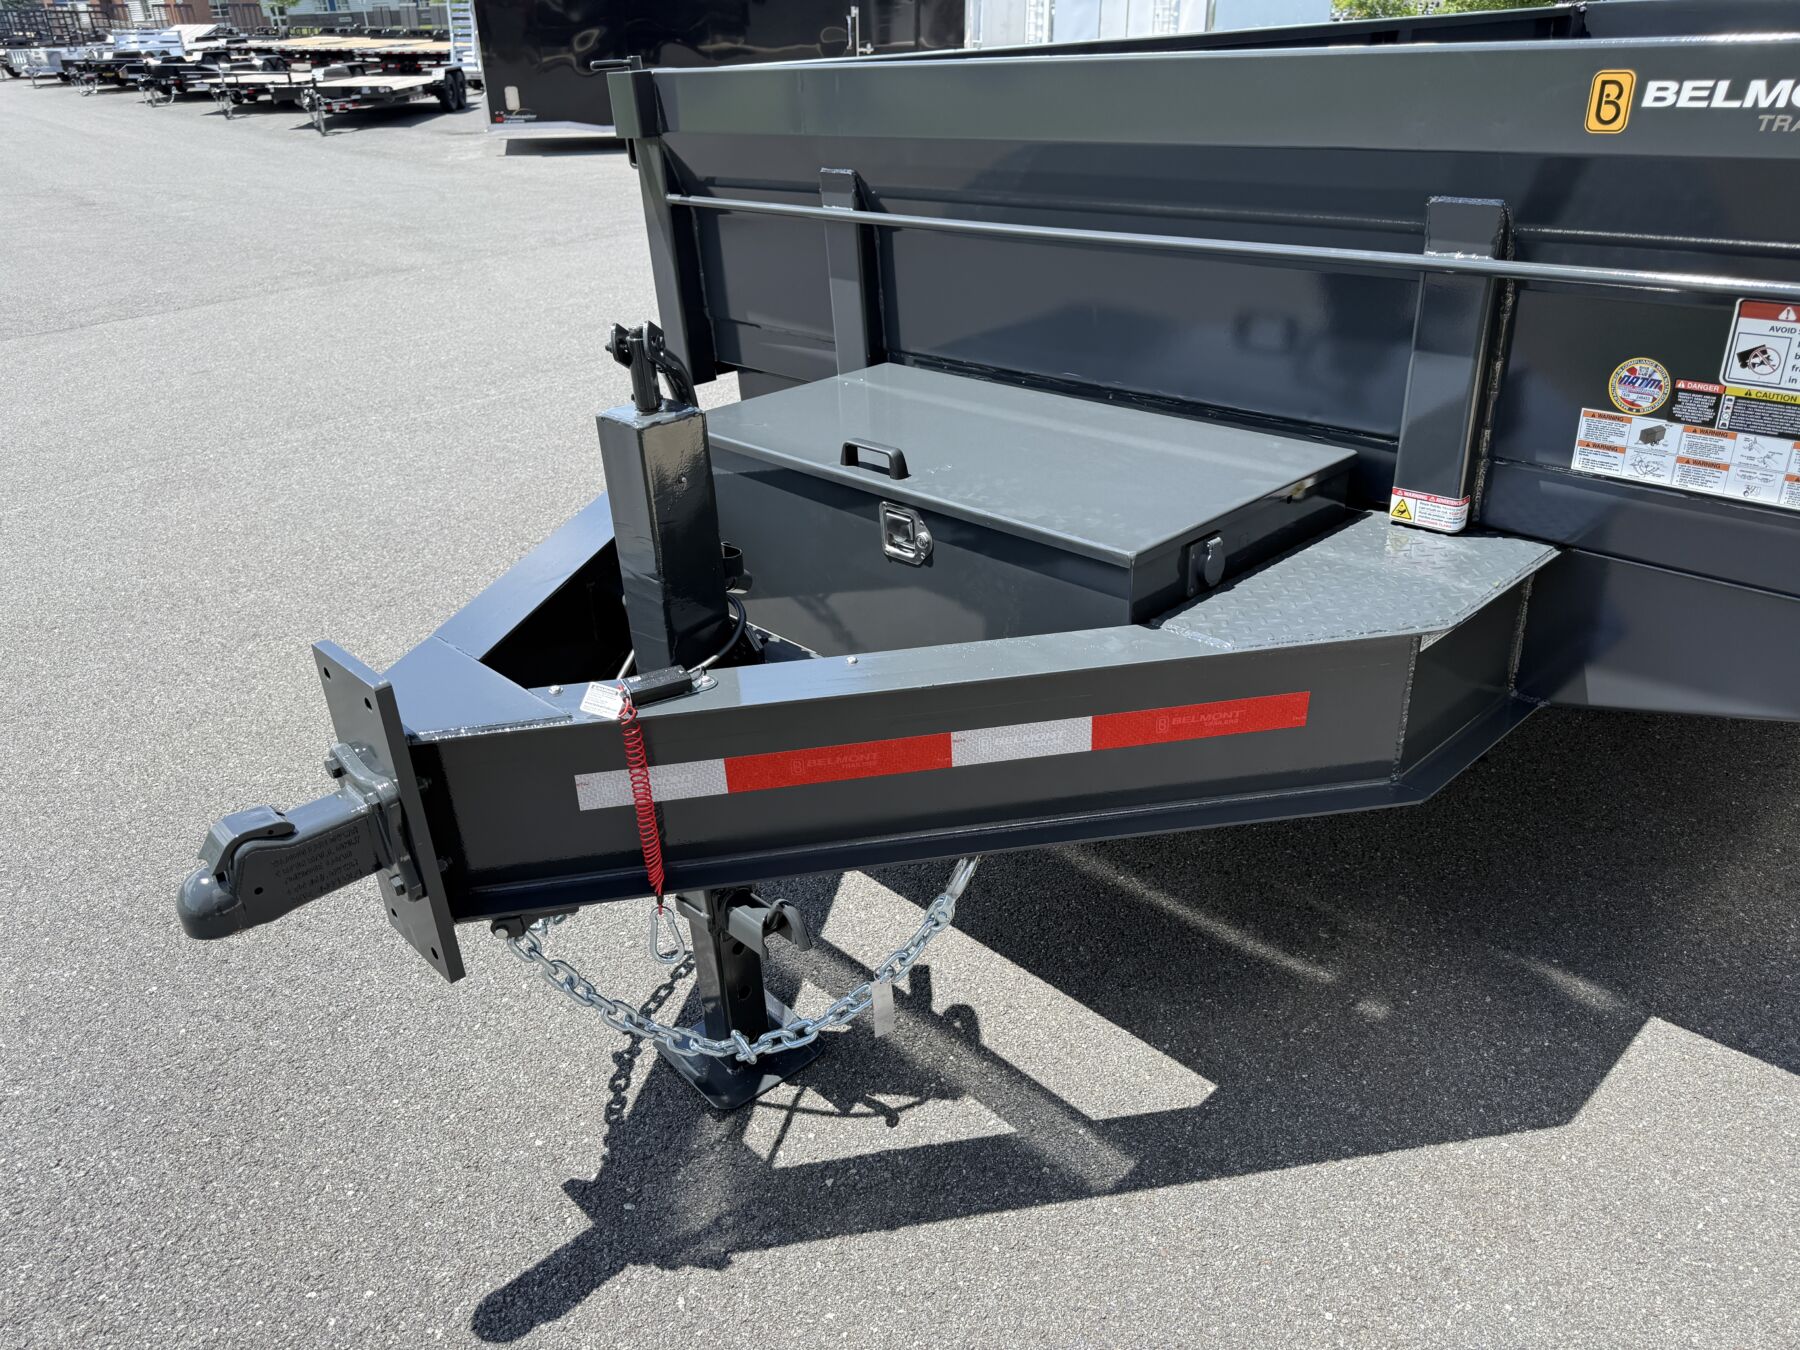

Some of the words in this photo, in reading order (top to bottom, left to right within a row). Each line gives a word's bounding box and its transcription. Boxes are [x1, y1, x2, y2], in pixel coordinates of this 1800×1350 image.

[1641, 79, 1800, 108] BELM
[1769, 325, 1797, 334] AVOID
[1687, 381, 1720, 392] DANGER
[1755, 391, 1798, 402] CAUTION
[1597, 413, 1624, 422] WARNING
[1699, 428, 1728, 438] WARNING
[1592, 443, 1617, 452] WARNING
[1692, 459, 1721, 469] WARNING
[1172, 709, 1247, 725] BELMONT
[807, 752, 881, 767] BELMONT
